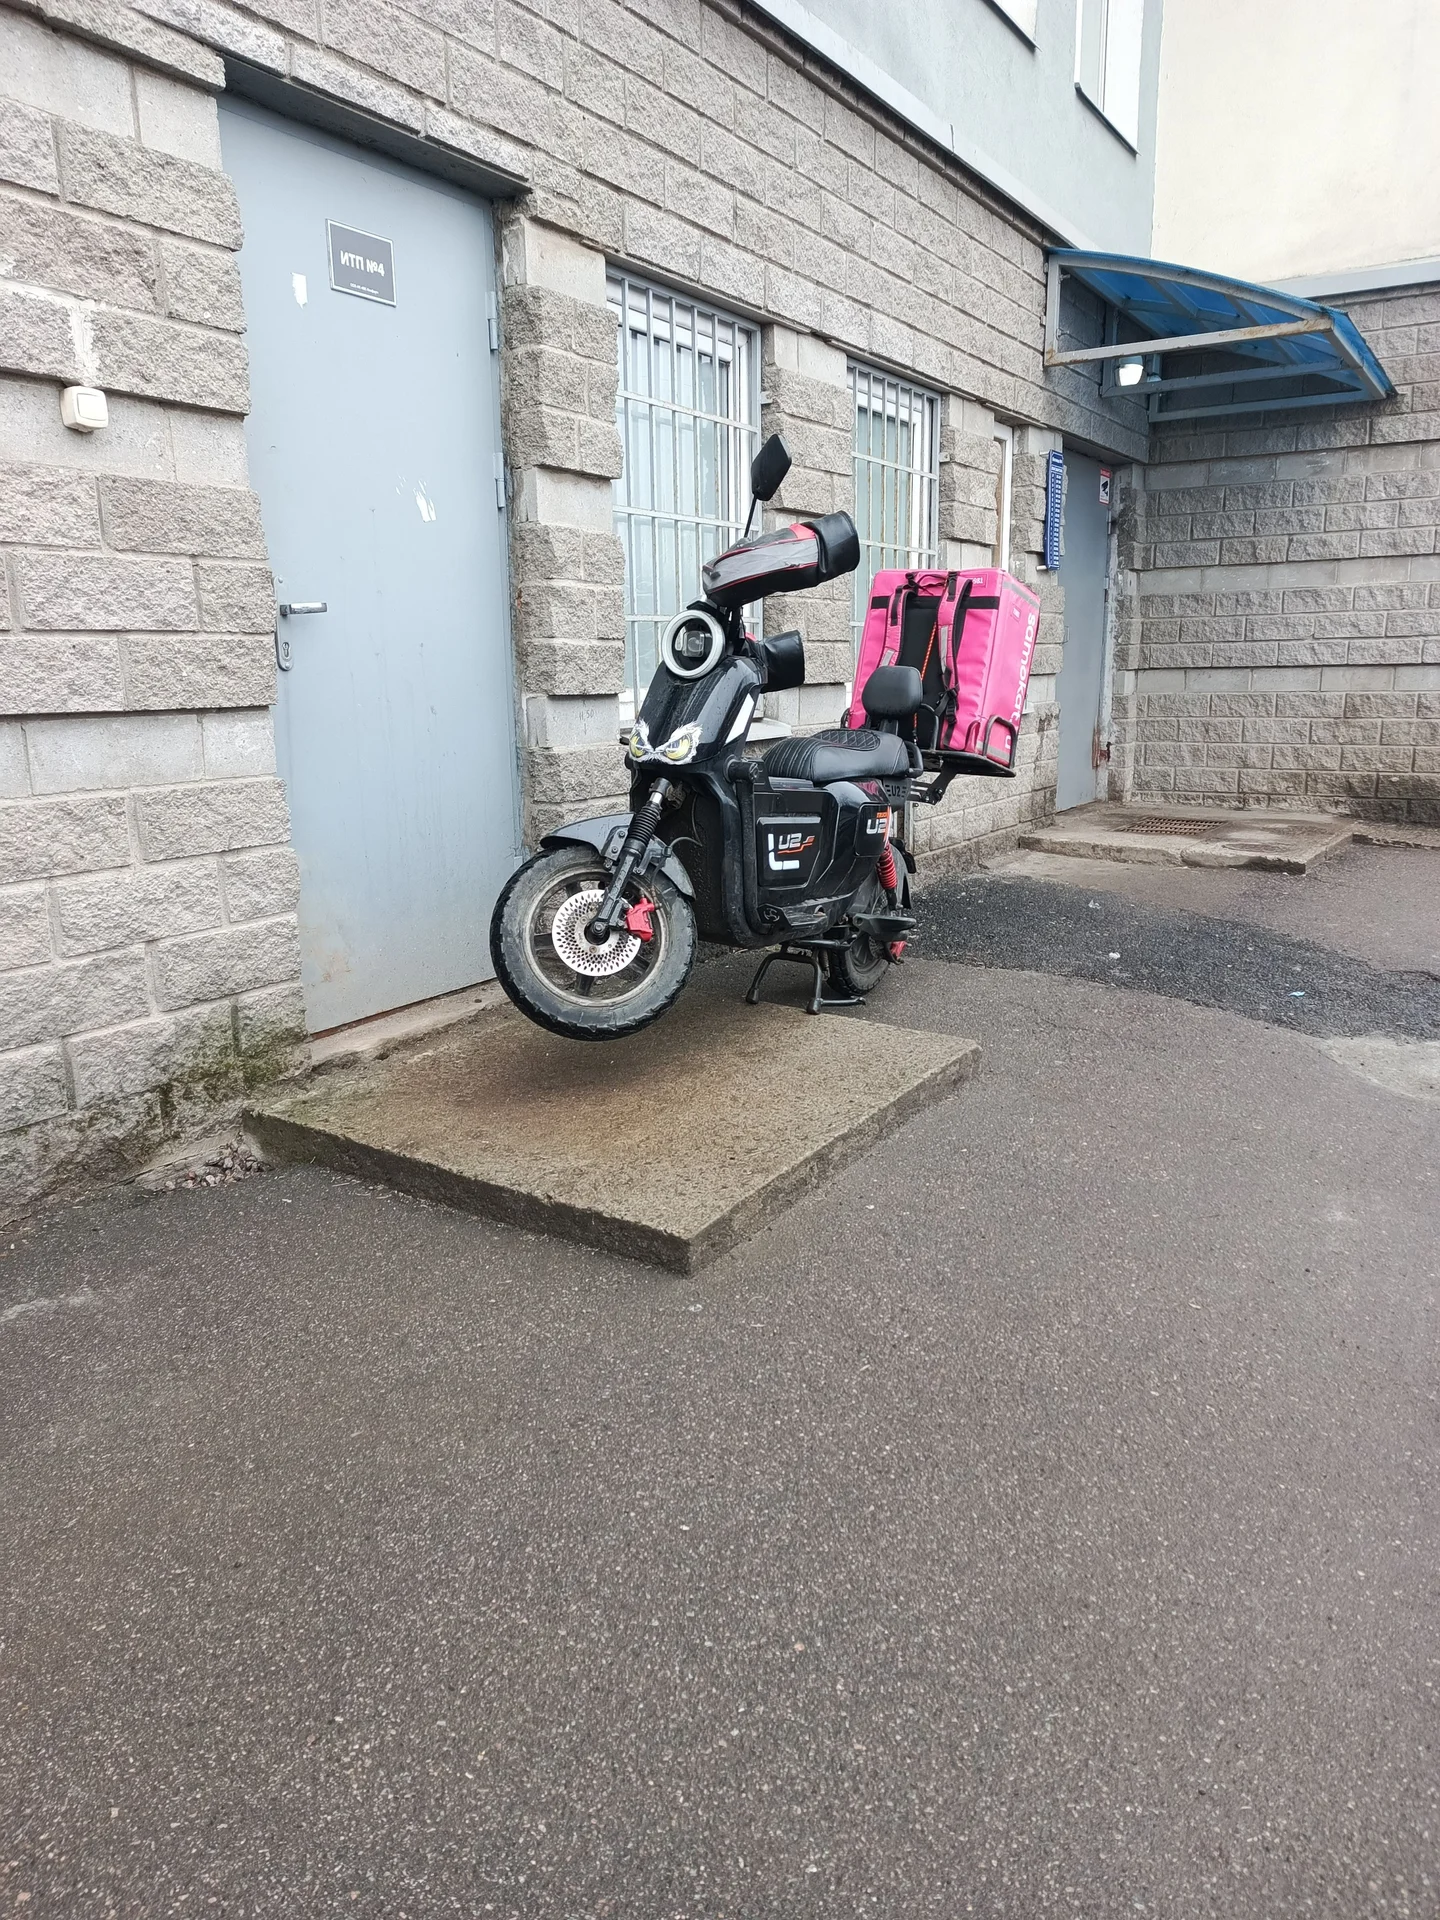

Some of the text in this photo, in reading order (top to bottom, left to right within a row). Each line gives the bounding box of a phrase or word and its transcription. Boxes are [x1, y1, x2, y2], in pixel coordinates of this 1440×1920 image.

[340, 250, 385, 277] ИТП №4
[891, 785, 901, 797] U2
